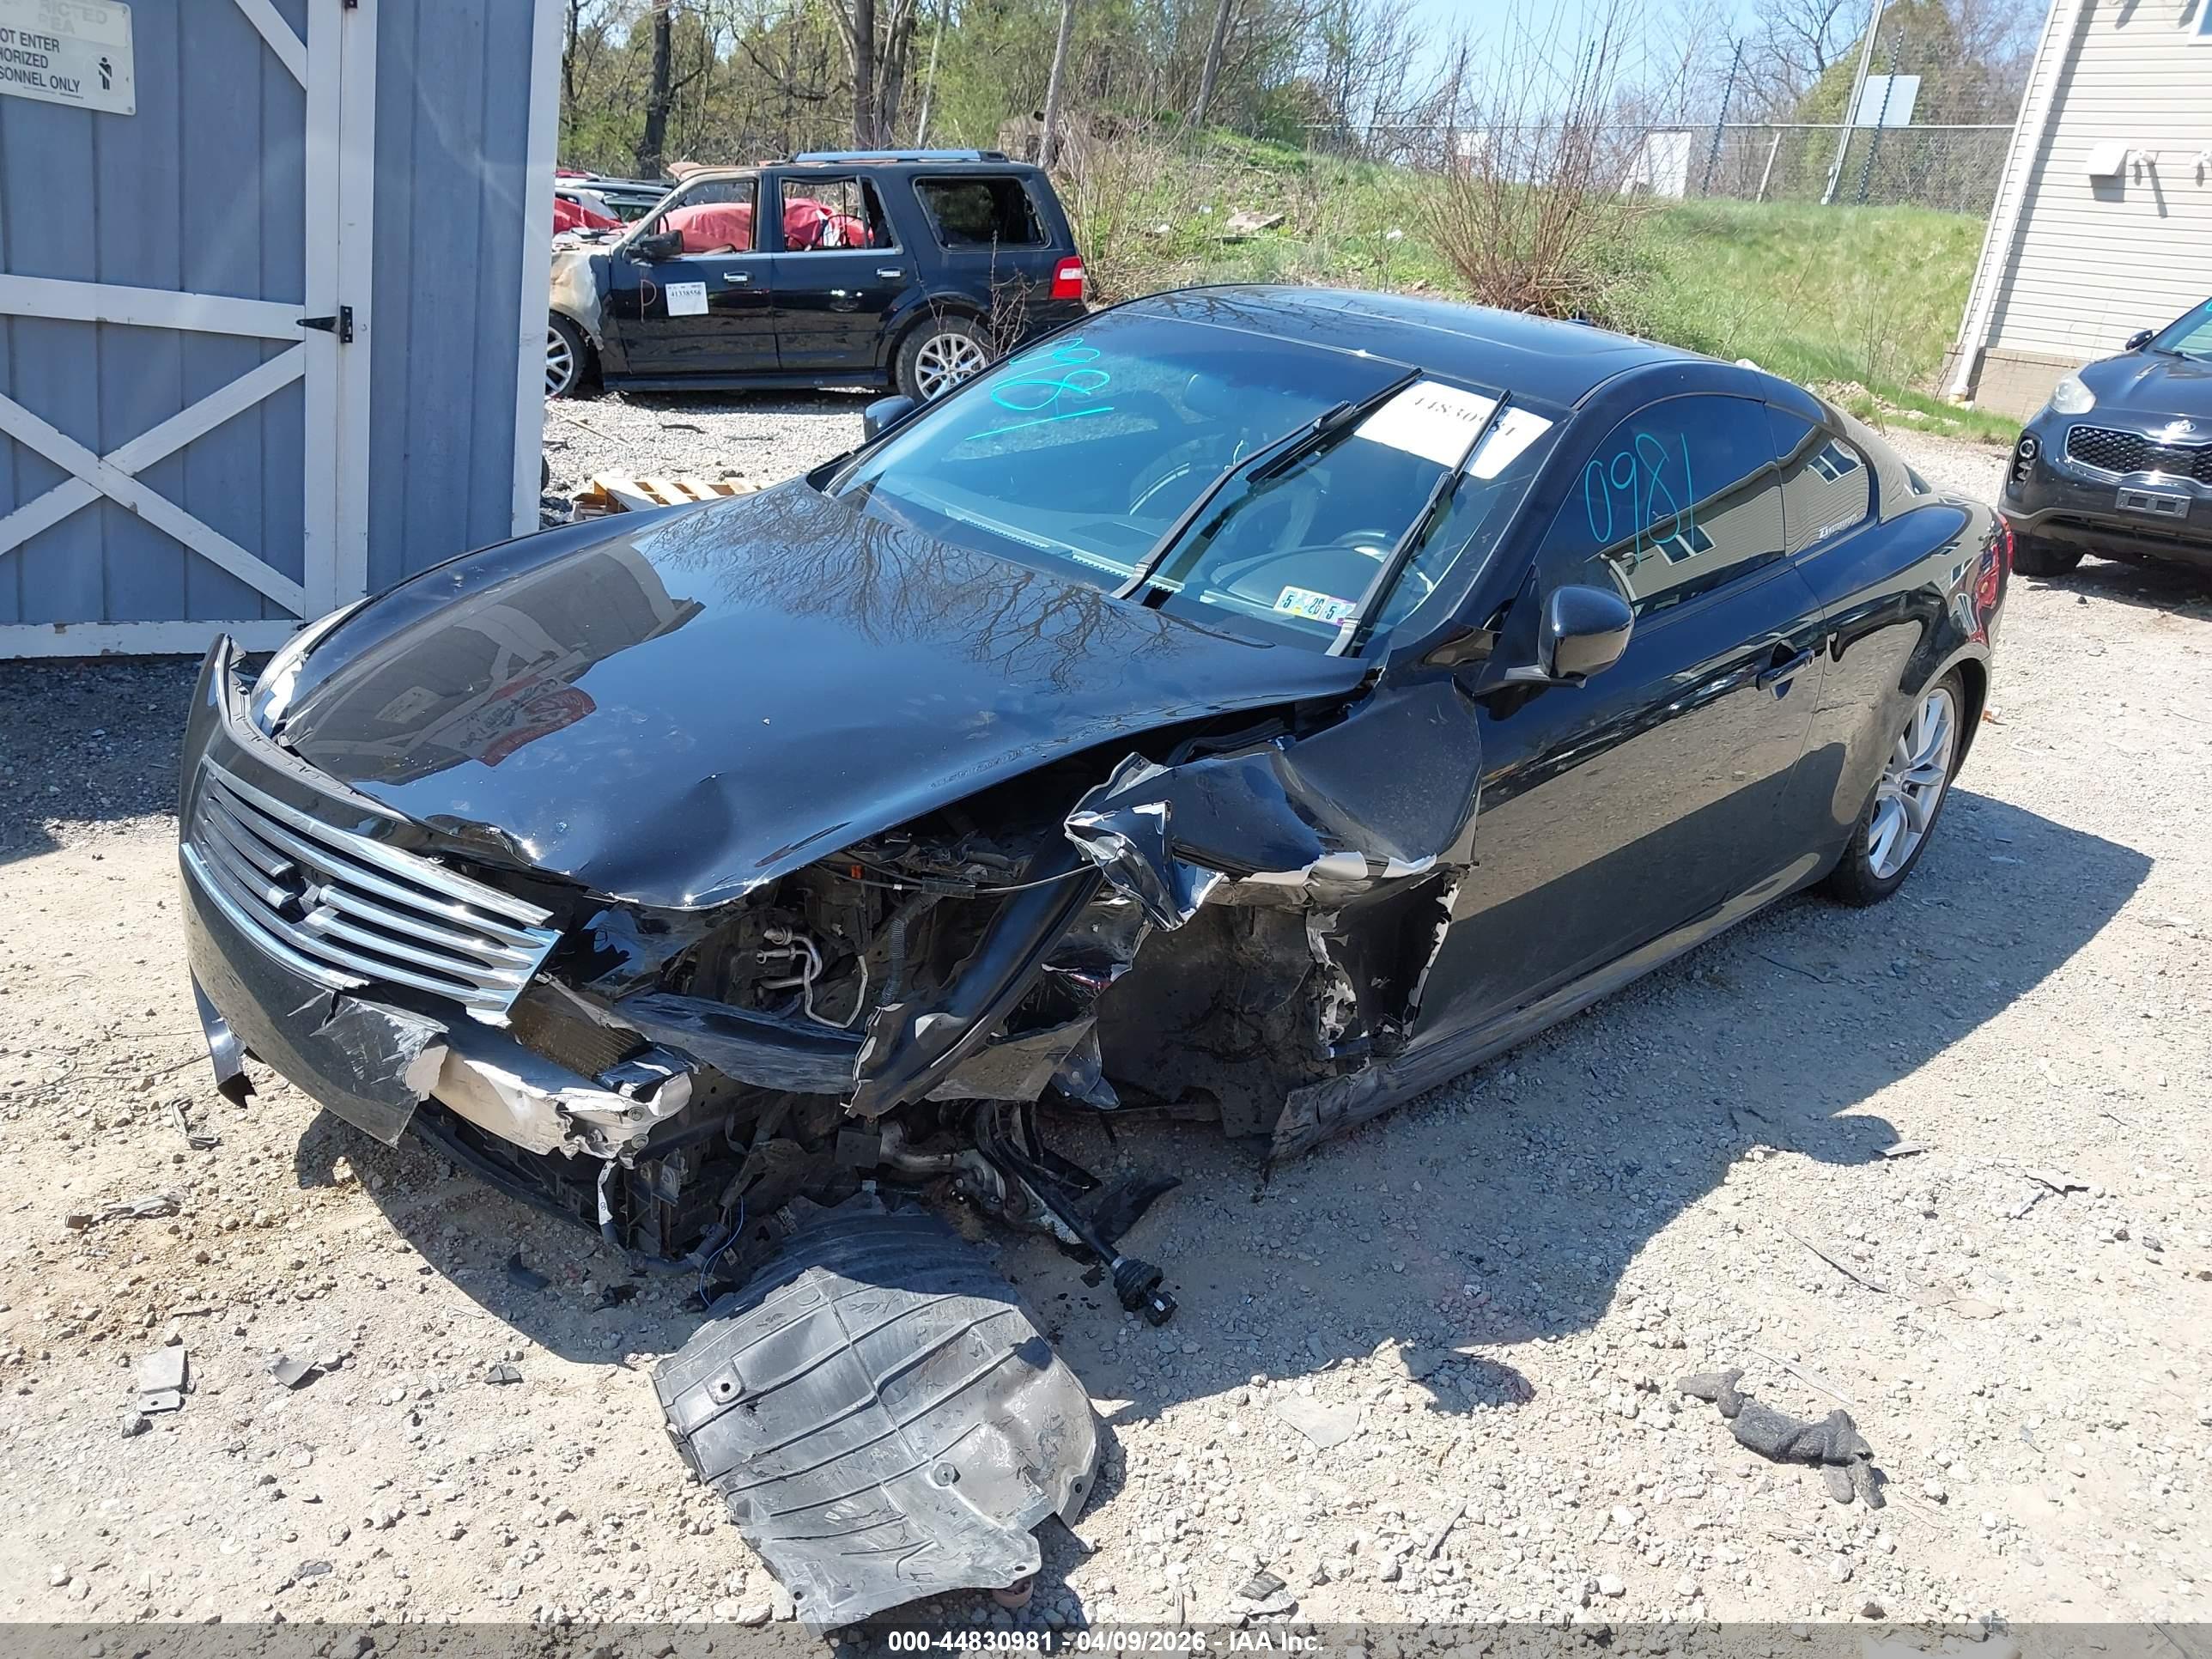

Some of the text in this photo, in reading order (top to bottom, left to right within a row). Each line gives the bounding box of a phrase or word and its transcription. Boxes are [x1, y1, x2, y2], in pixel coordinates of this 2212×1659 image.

[20, 32, 60, 53] ENTER
[50, 75, 80, 94] ONLY
[1584, 432, 1694, 570] 0981
